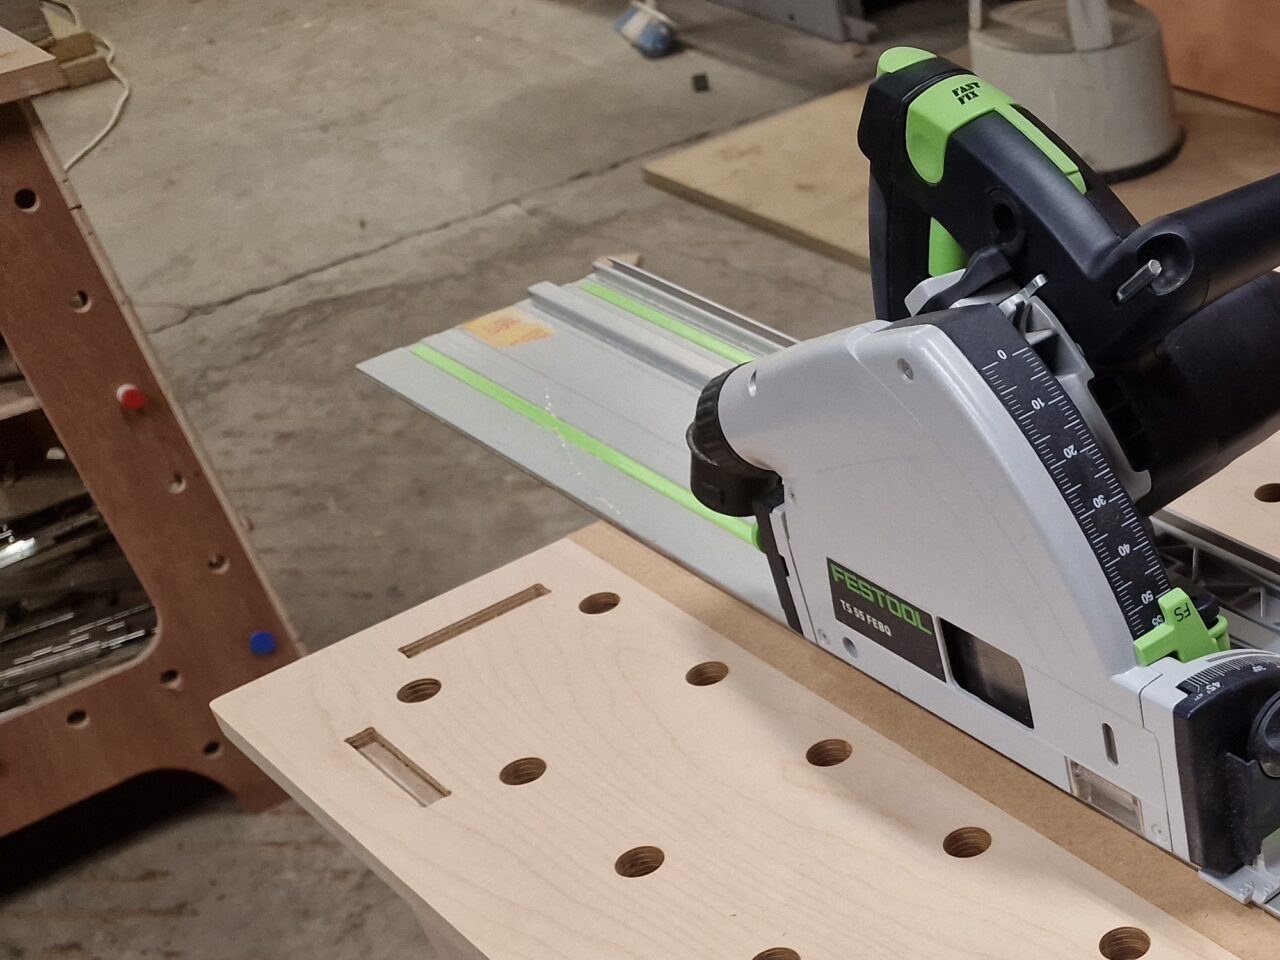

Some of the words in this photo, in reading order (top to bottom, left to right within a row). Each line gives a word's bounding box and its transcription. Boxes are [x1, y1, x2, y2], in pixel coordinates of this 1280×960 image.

[952, 82, 980, 97] FAST
[958, 90, 979, 105] FIX
[997, 349, 1007, 360] 0
[1031, 397, 1045, 410] 10
[1063, 444, 1078, 459] 20
[1092, 494, 1107, 509] 30
[1117, 543, 1131, 557] 40
[830, 563, 932, 635] FESTOOL
[1141, 590, 1154, 605] 50
[840, 599, 853, 614] TS
[853, 607, 865, 622] 55
[866, 614, 892, 637] FEBQ
[1173, 602, 1192, 622] FS
